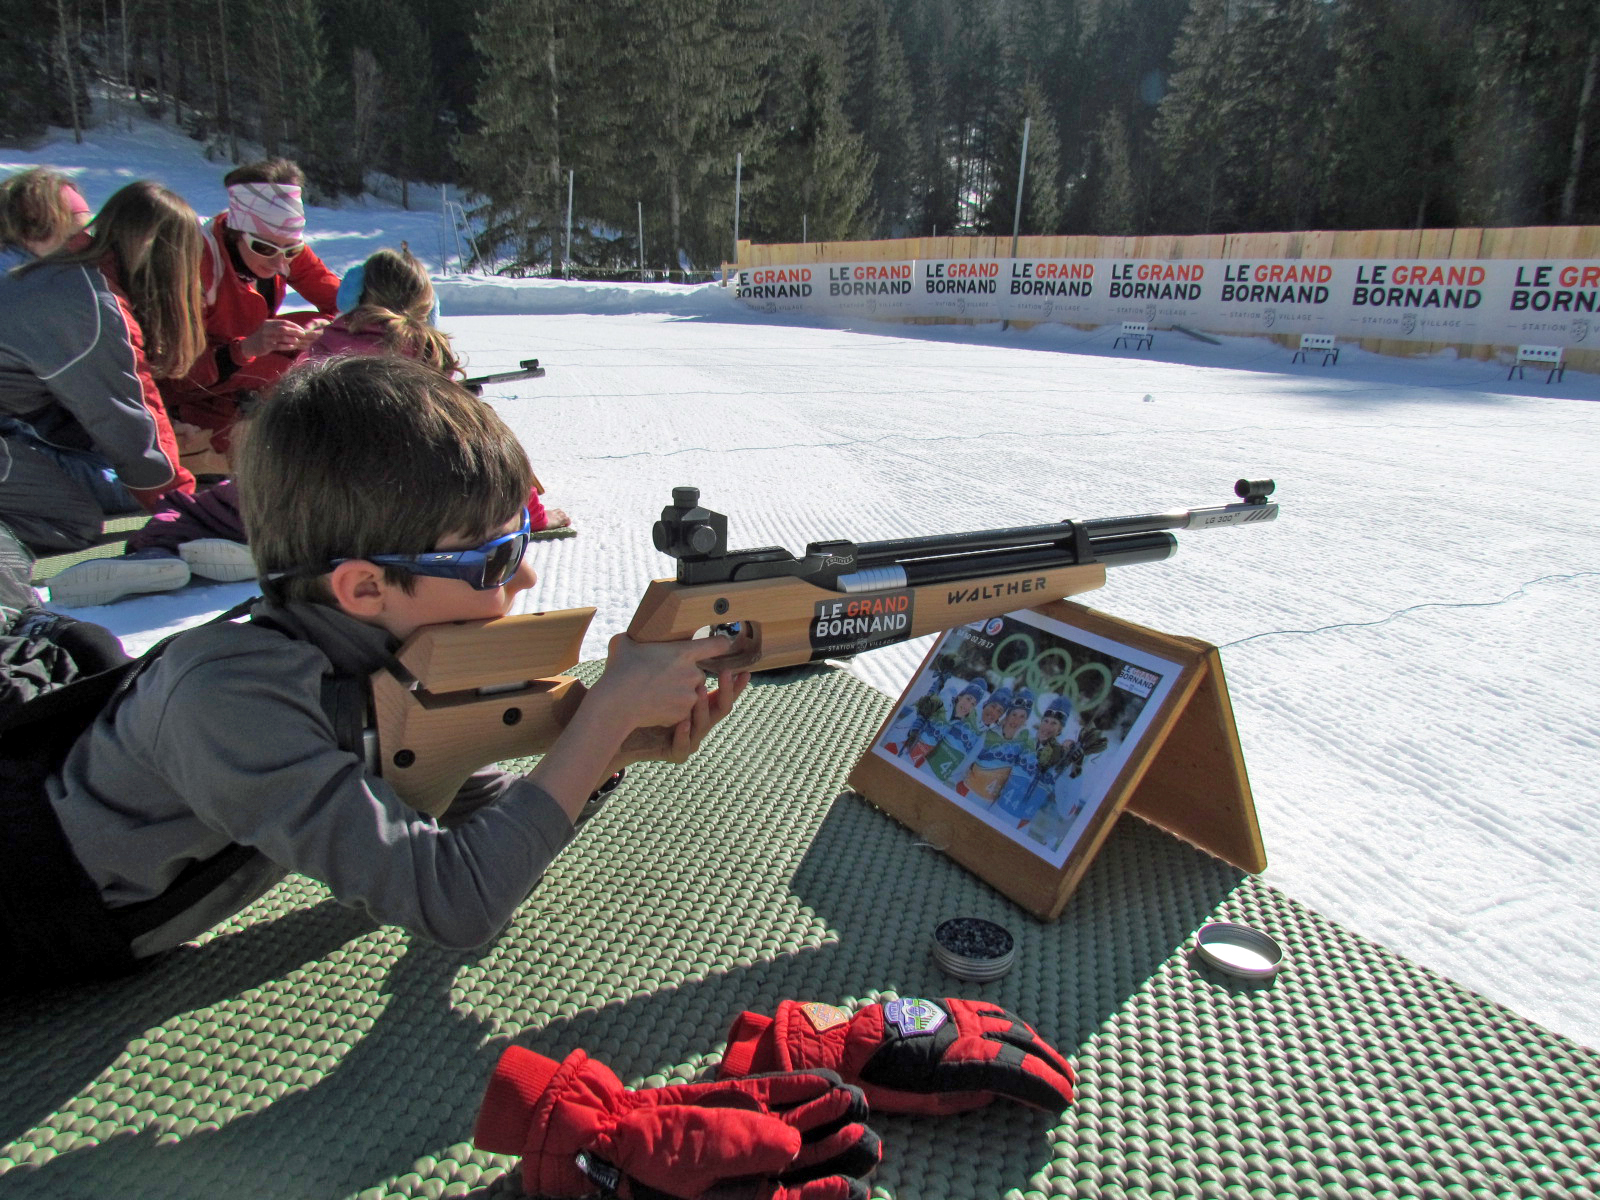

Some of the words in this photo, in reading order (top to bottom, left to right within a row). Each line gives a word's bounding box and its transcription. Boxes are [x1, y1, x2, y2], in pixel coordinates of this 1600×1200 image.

[736, 272, 750, 286] E
[753, 268, 812, 285] GRAND
[829, 267, 850, 280] LE
[853, 265, 911, 280] GRAND
[926, 264, 944, 278] LE
[947, 263, 999, 278] GRAND
[1012, 263, 1033, 279] LE
[1035, 263, 1095, 280] GRAND
[1111, 264, 1134, 280] LE
[1137, 264, 1204, 281] GRAND
[1224, 265, 1250, 282] LE
[1254, 265, 1332, 283] GRAND
[1356, 266, 1387, 284] LE
[1392, 266, 1486, 286] GRAND
[1514, 266, 1552, 287] LE
[736, 283, 812, 299] BORNAND
[829, 281, 912, 297] BORNAND
[925, 279, 997, 294] BORNAND
[1010, 280, 1093, 297] BORNAND
[1109, 283, 1201, 300] BORNAND
[1221, 285, 1329, 304] BORNAND
[1352, 287, 1482, 309] BORNAND
[1510, 290, 1600, 313] BORN
[1117, 307, 1144, 315] STATION
[1361, 317, 1399, 325] STATION
[1419, 320, 1462, 328] VILLAGE
[1521, 323, 1567, 331] STATION
[1205, 517, 1216, 525] LG
[1217, 515, 1233, 523] 300
[947, 577, 1047, 605] WALTHER
[820, 603, 843, 620] LE
[847, 595, 910, 617] GRAND
[816, 613, 907, 638] BORNAND
[828, 643, 855, 652] STATION
[1119, 671, 1155, 690] BORNAND
